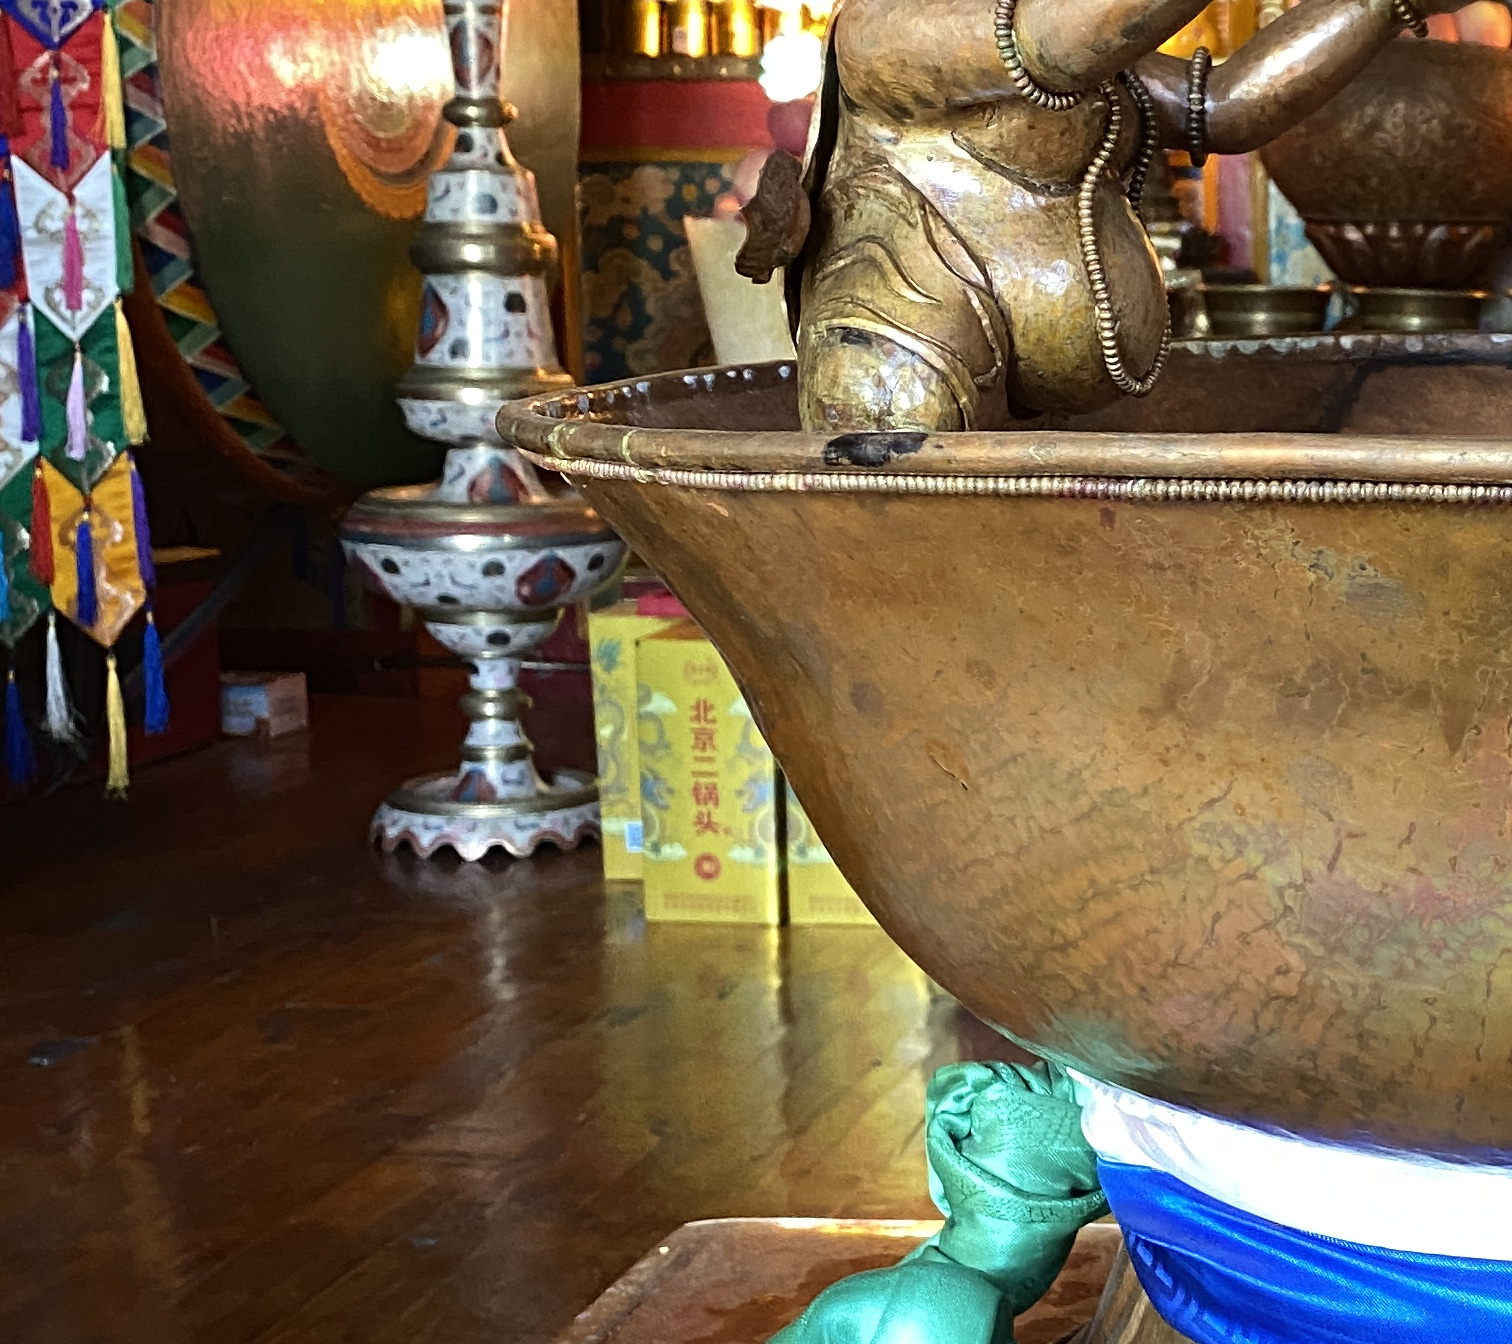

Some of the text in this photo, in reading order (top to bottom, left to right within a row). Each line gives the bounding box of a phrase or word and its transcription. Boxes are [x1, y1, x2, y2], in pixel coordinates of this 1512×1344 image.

[690, 697, 719, 836] 北京二锅头
